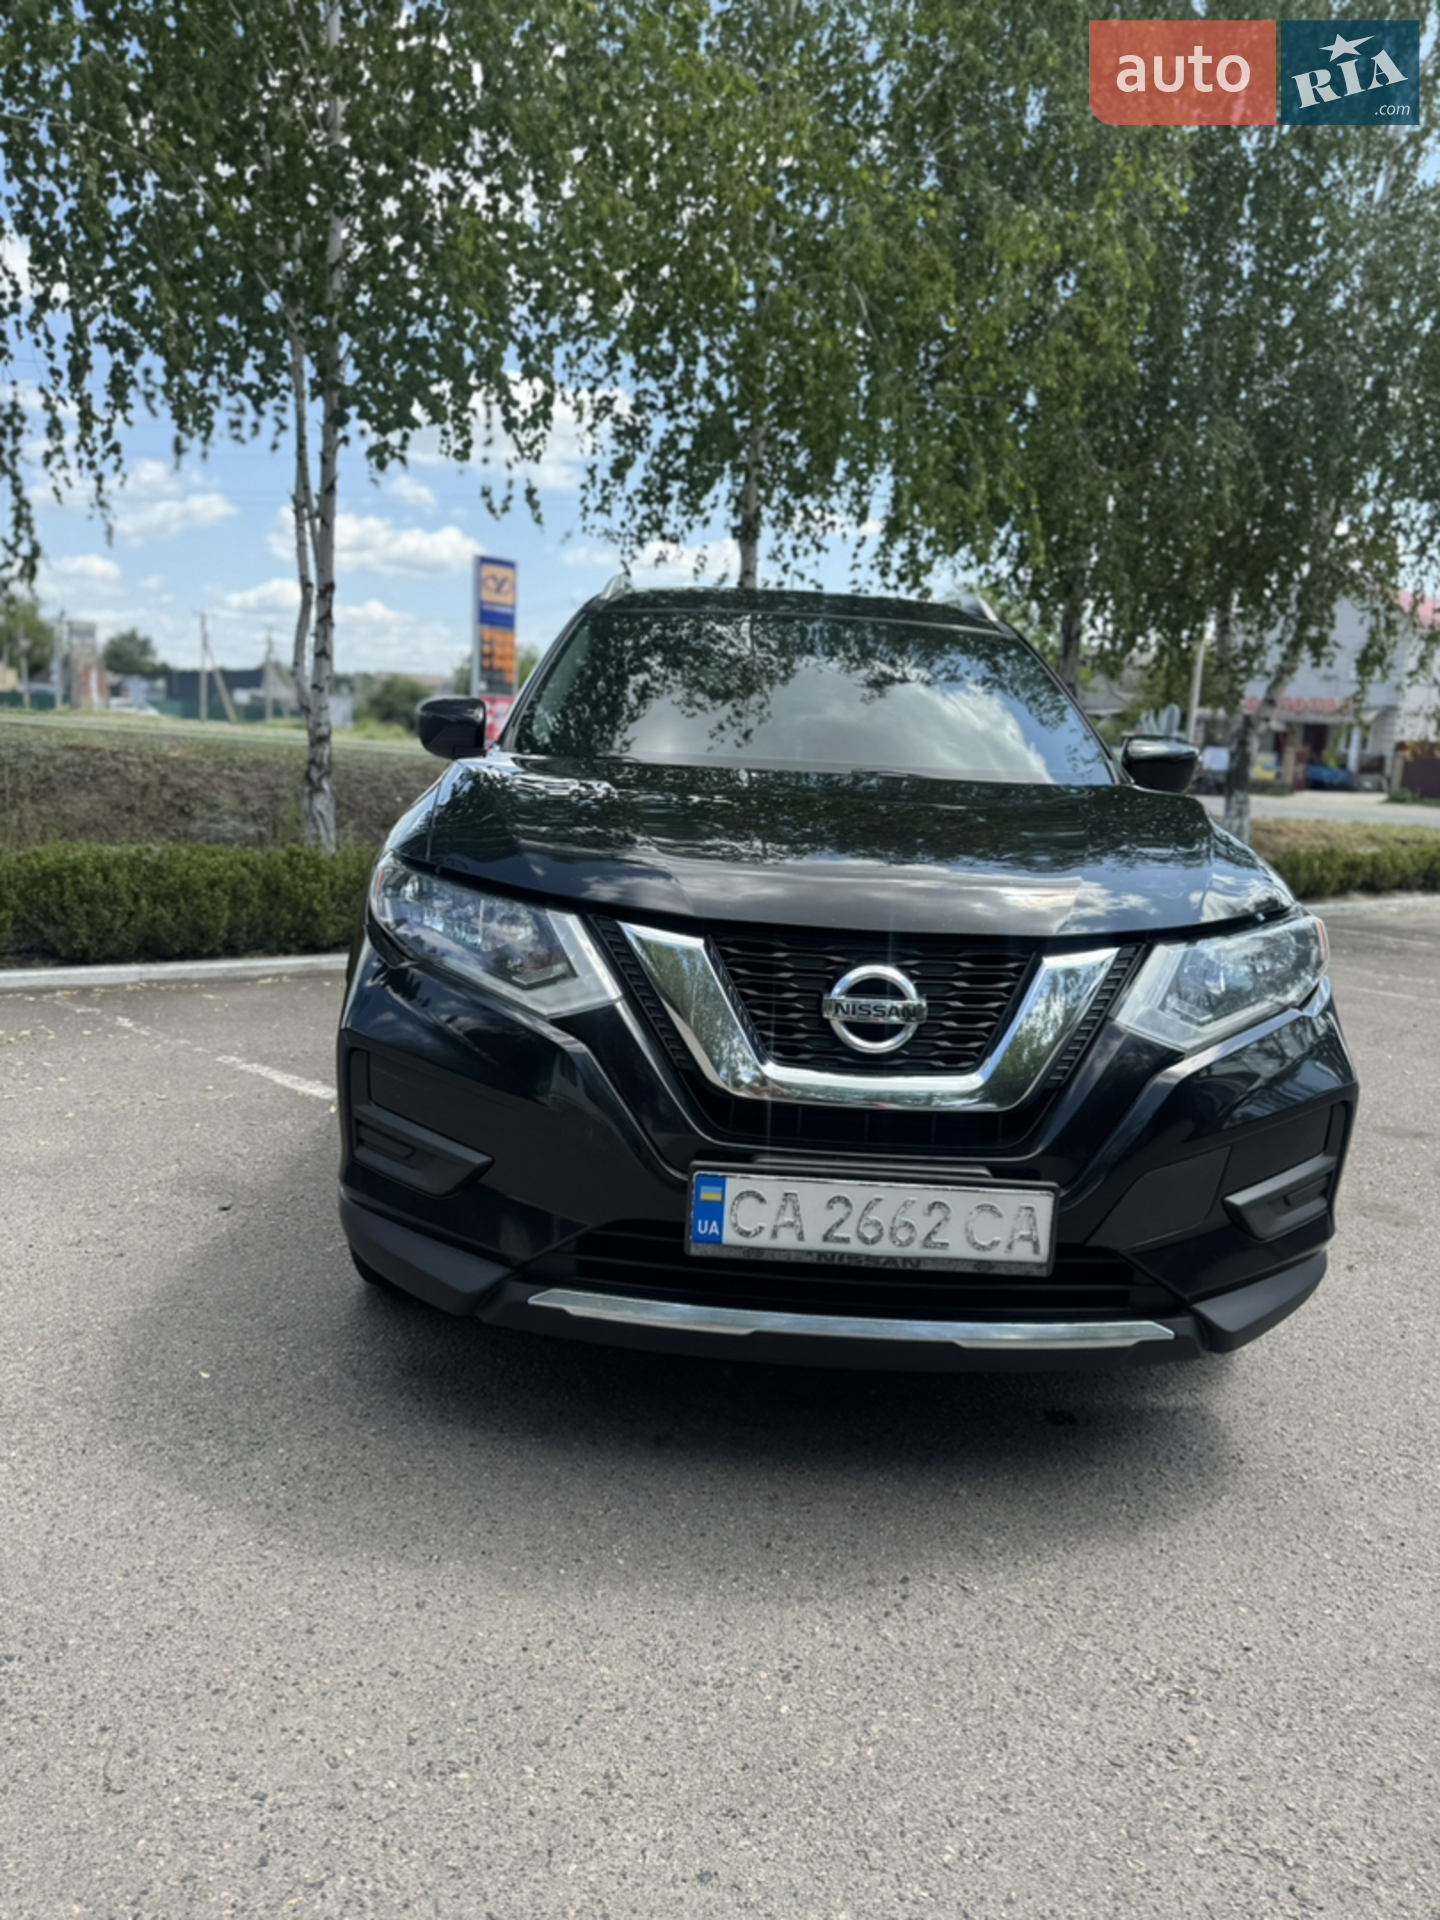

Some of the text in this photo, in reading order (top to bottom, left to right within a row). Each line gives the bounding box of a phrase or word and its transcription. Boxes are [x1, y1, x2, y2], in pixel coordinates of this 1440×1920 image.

[834, 1002, 917, 1018] NISSAN
[698, 1219, 719, 1235] UA
[729, 1189, 1042, 1256] CA 2662 CA
